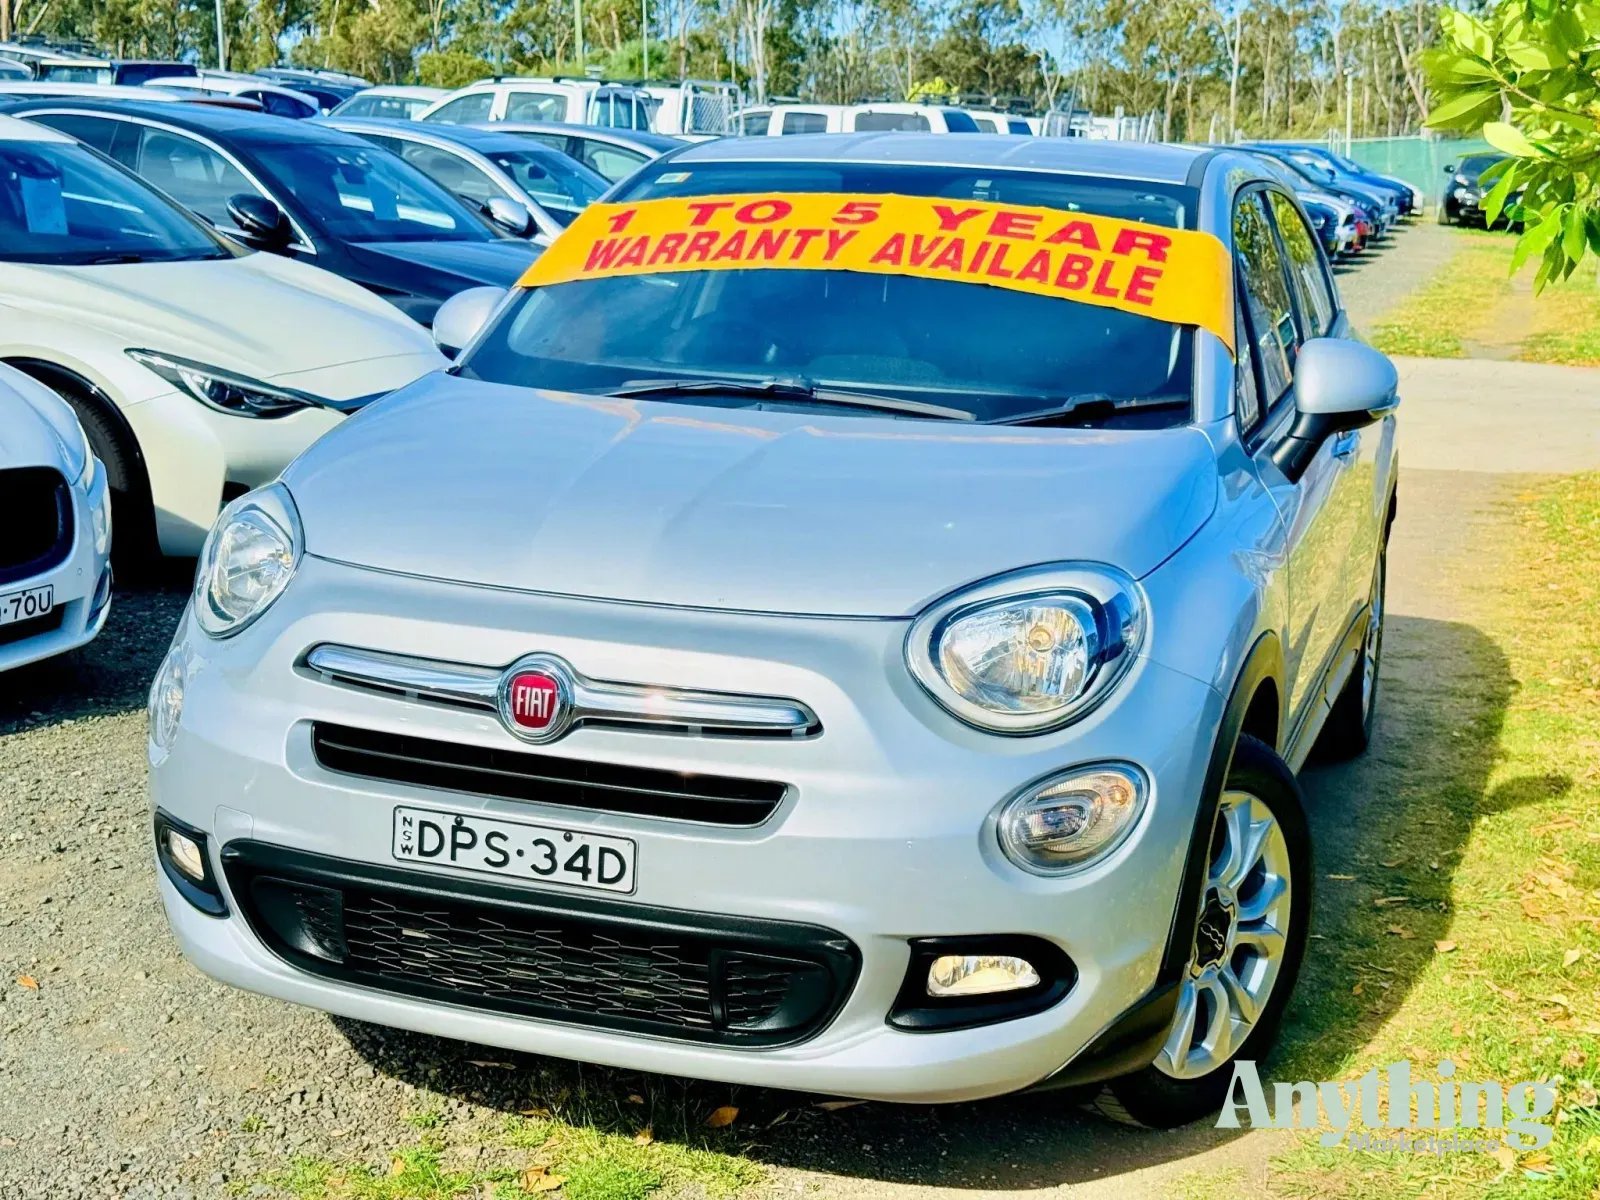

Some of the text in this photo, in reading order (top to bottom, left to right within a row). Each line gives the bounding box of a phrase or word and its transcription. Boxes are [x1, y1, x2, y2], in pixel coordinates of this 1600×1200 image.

[607, 199, 1172, 263] 1 TO 5 YEAR
[582, 228, 1164, 306] WARRANTY AVAILABLE
[516, 685, 554, 719] FIAT
